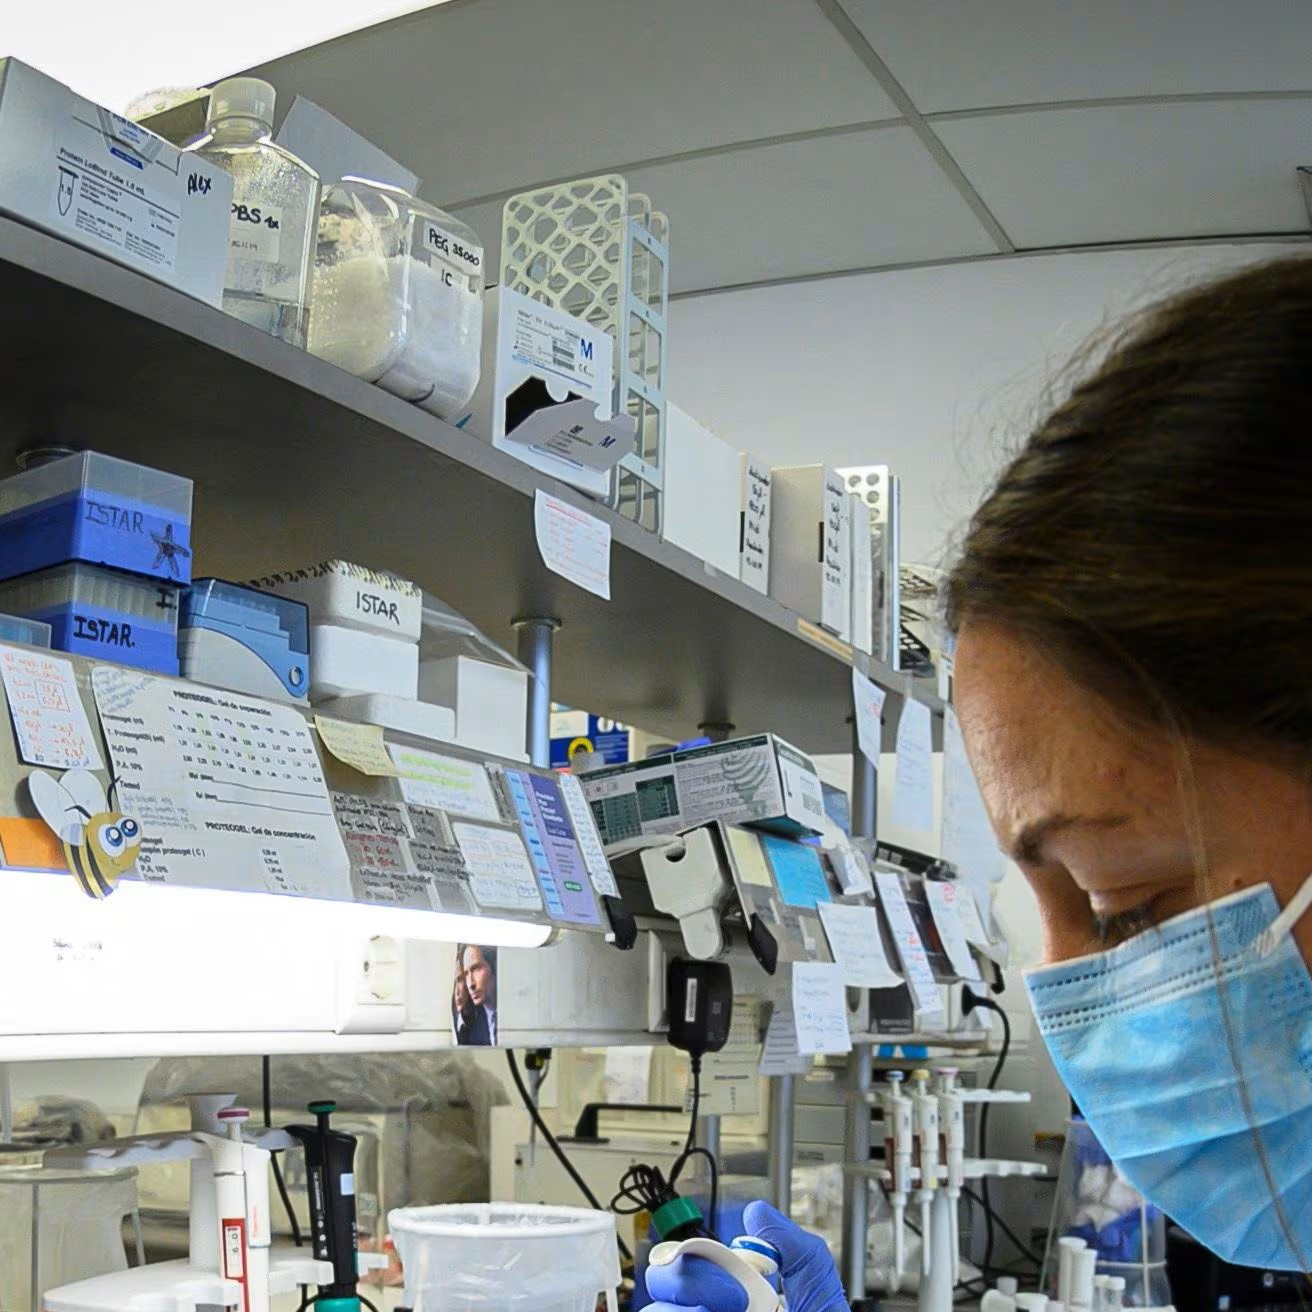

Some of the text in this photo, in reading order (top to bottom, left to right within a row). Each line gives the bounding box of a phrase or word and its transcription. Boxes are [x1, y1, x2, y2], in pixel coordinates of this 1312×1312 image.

[429, 228, 480, 267] PEG 35000
[85, 501, 145, 534] ISTAR
[357, 591, 400, 625] ISTAR
